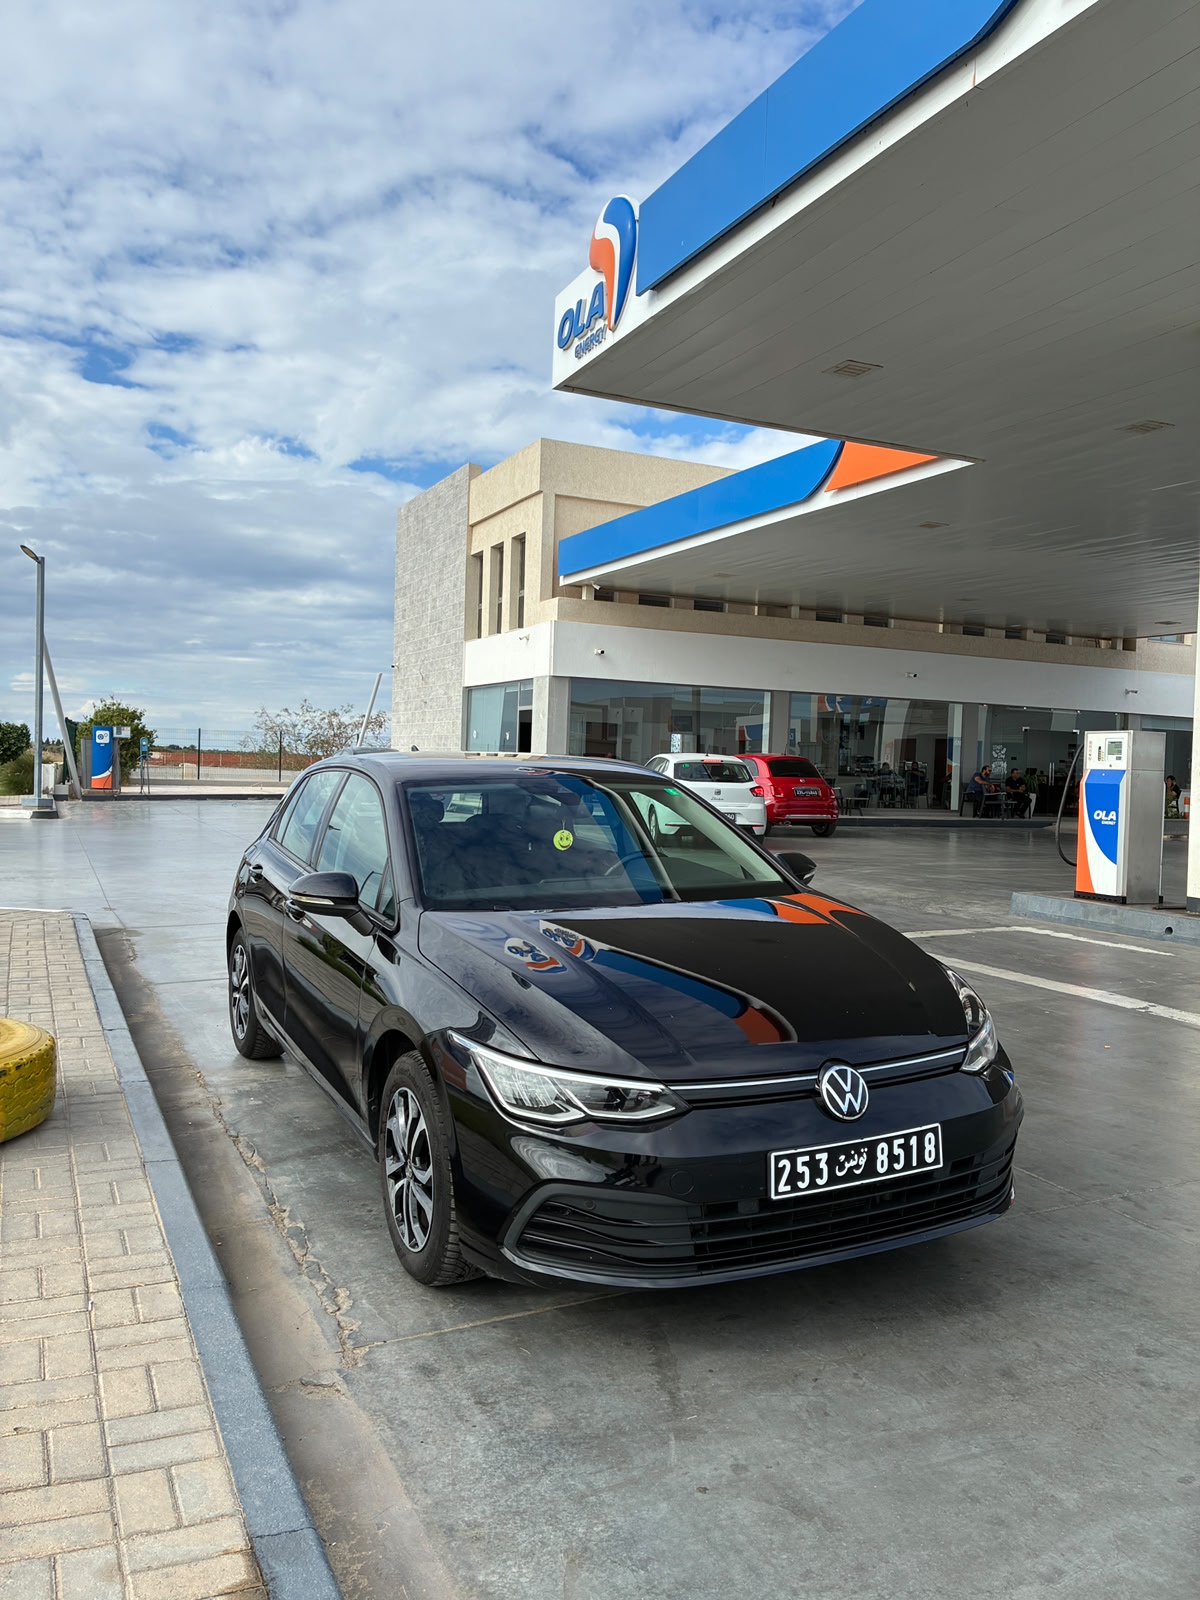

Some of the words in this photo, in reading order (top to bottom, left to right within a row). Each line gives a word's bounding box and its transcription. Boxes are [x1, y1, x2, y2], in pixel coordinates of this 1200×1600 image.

[557, 281, 606, 350] OLA
[574, 325, 607, 359] ENERGY
[1093, 809, 1116, 821] OLA
[777, 1152, 829, 1193] 253
[835, 1147, 868, 1177] تونس
[876, 1131, 936, 1174] 8518
